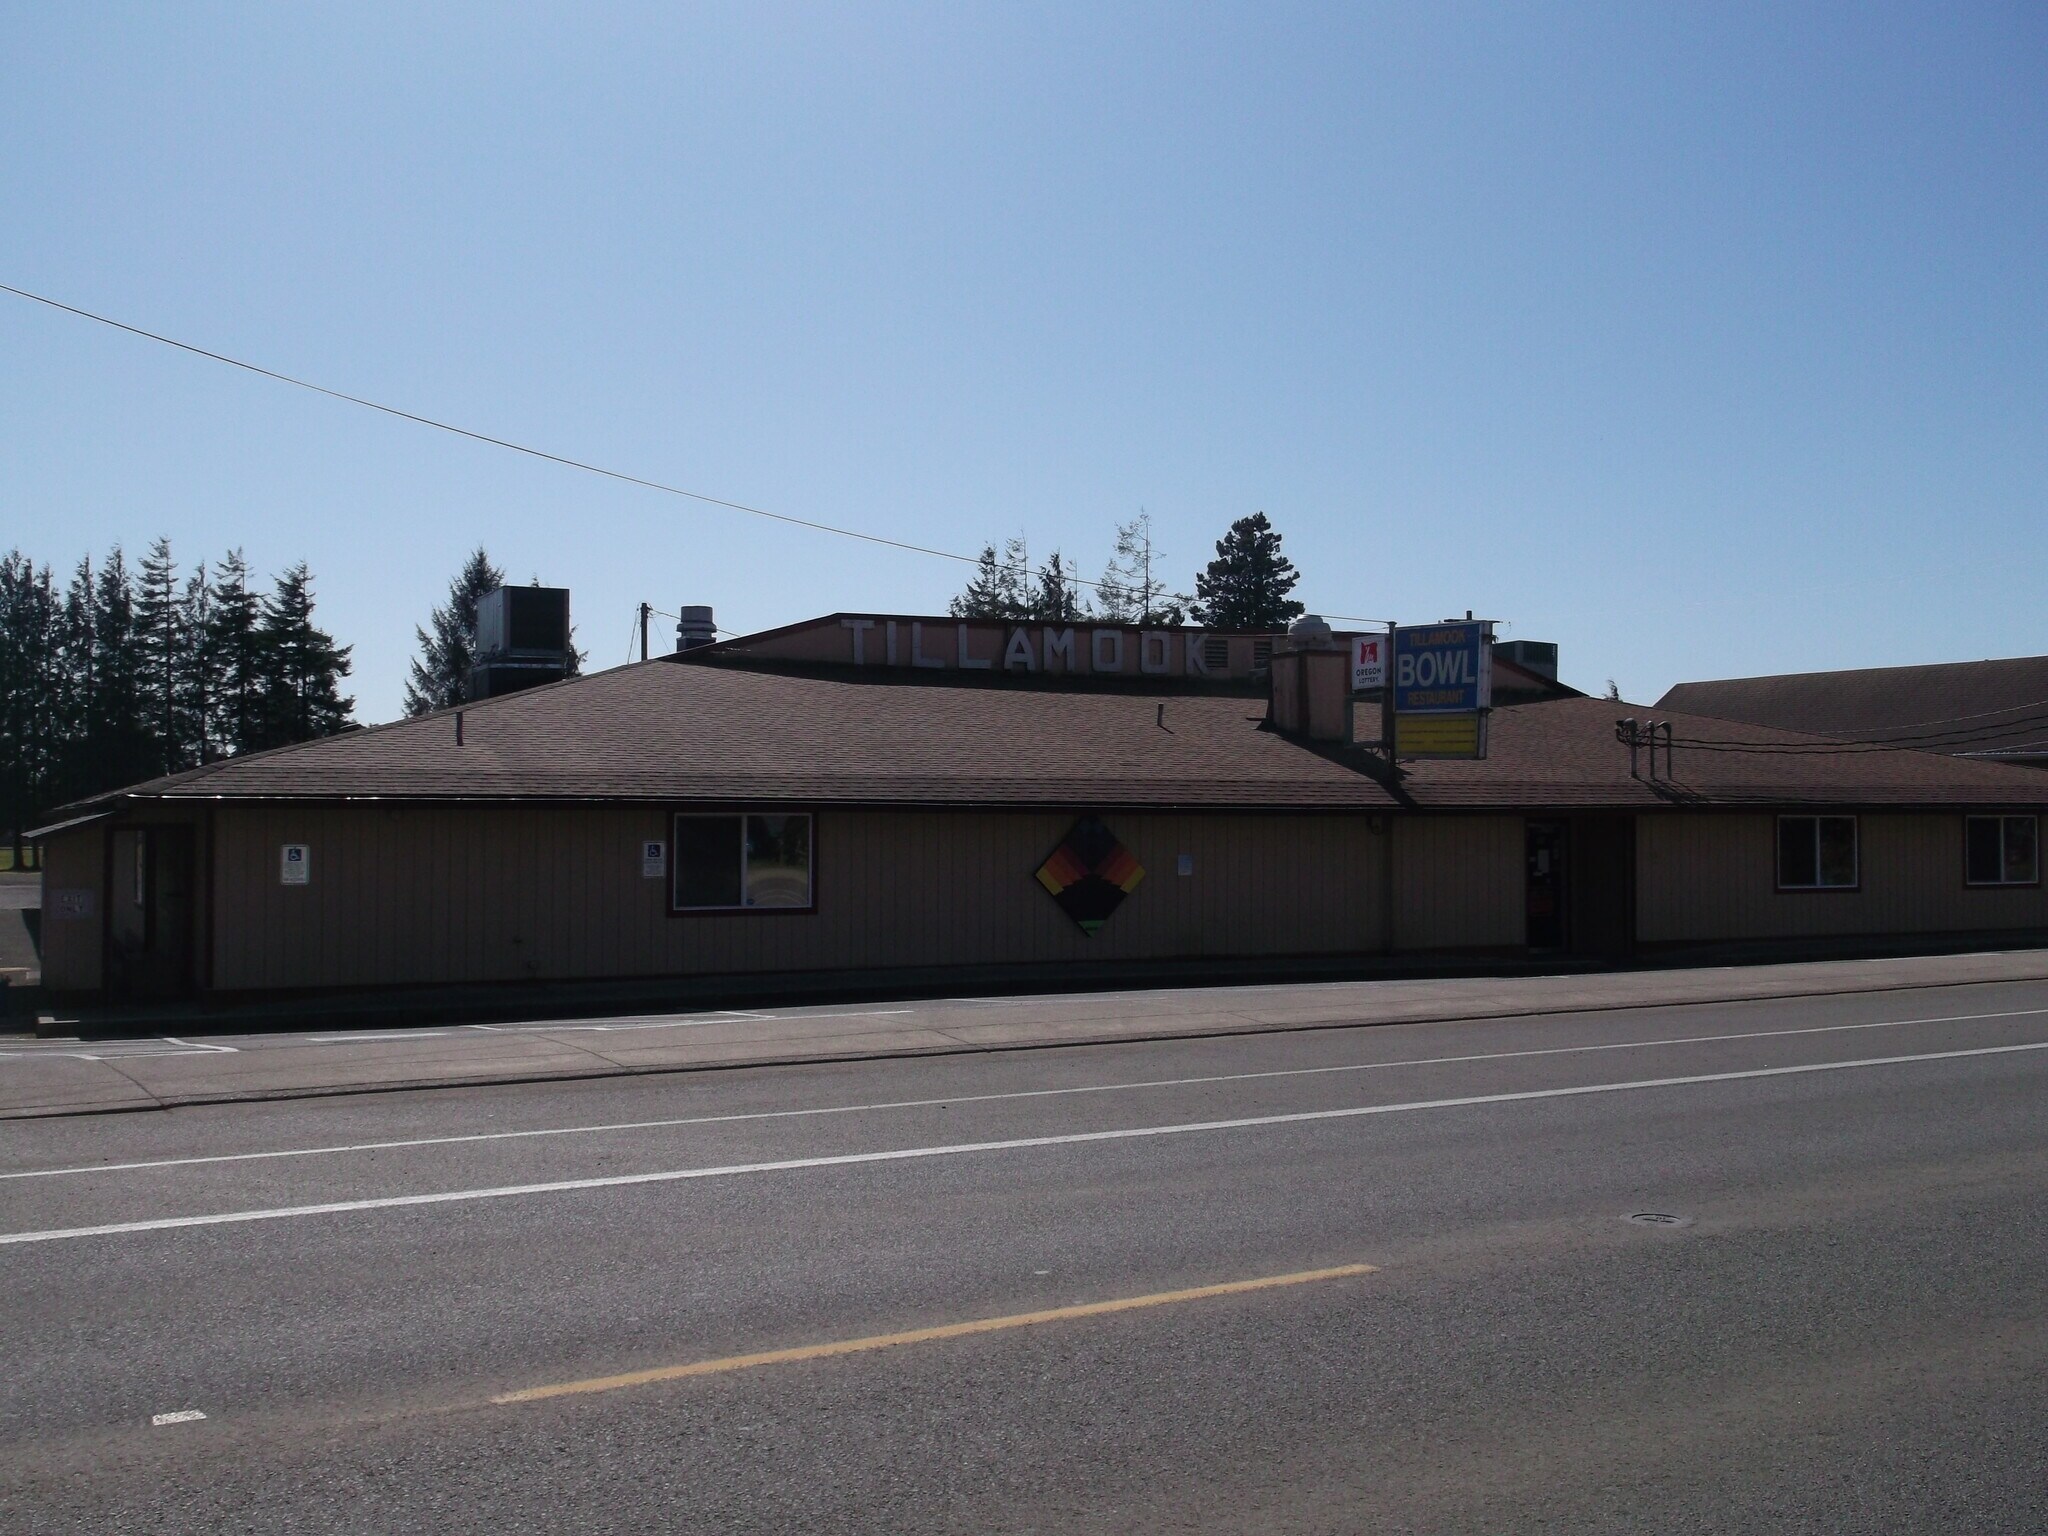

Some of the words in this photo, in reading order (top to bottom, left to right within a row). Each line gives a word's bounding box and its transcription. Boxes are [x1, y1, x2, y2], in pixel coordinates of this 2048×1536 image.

[1410, 630, 1465, 647] TILLAMOOK
[841, 619, 1211, 676] TILLAMOOK
[1355, 667, 1382, 676] OREGON
[1397, 650, 1476, 687] BOWL
[1358, 677, 1379, 685] LOTTERY
[1408, 690, 1464, 705] RESTAURANT
[61, 894, 82, 903] EXIT
[60, 905, 83, 913] ONLY
